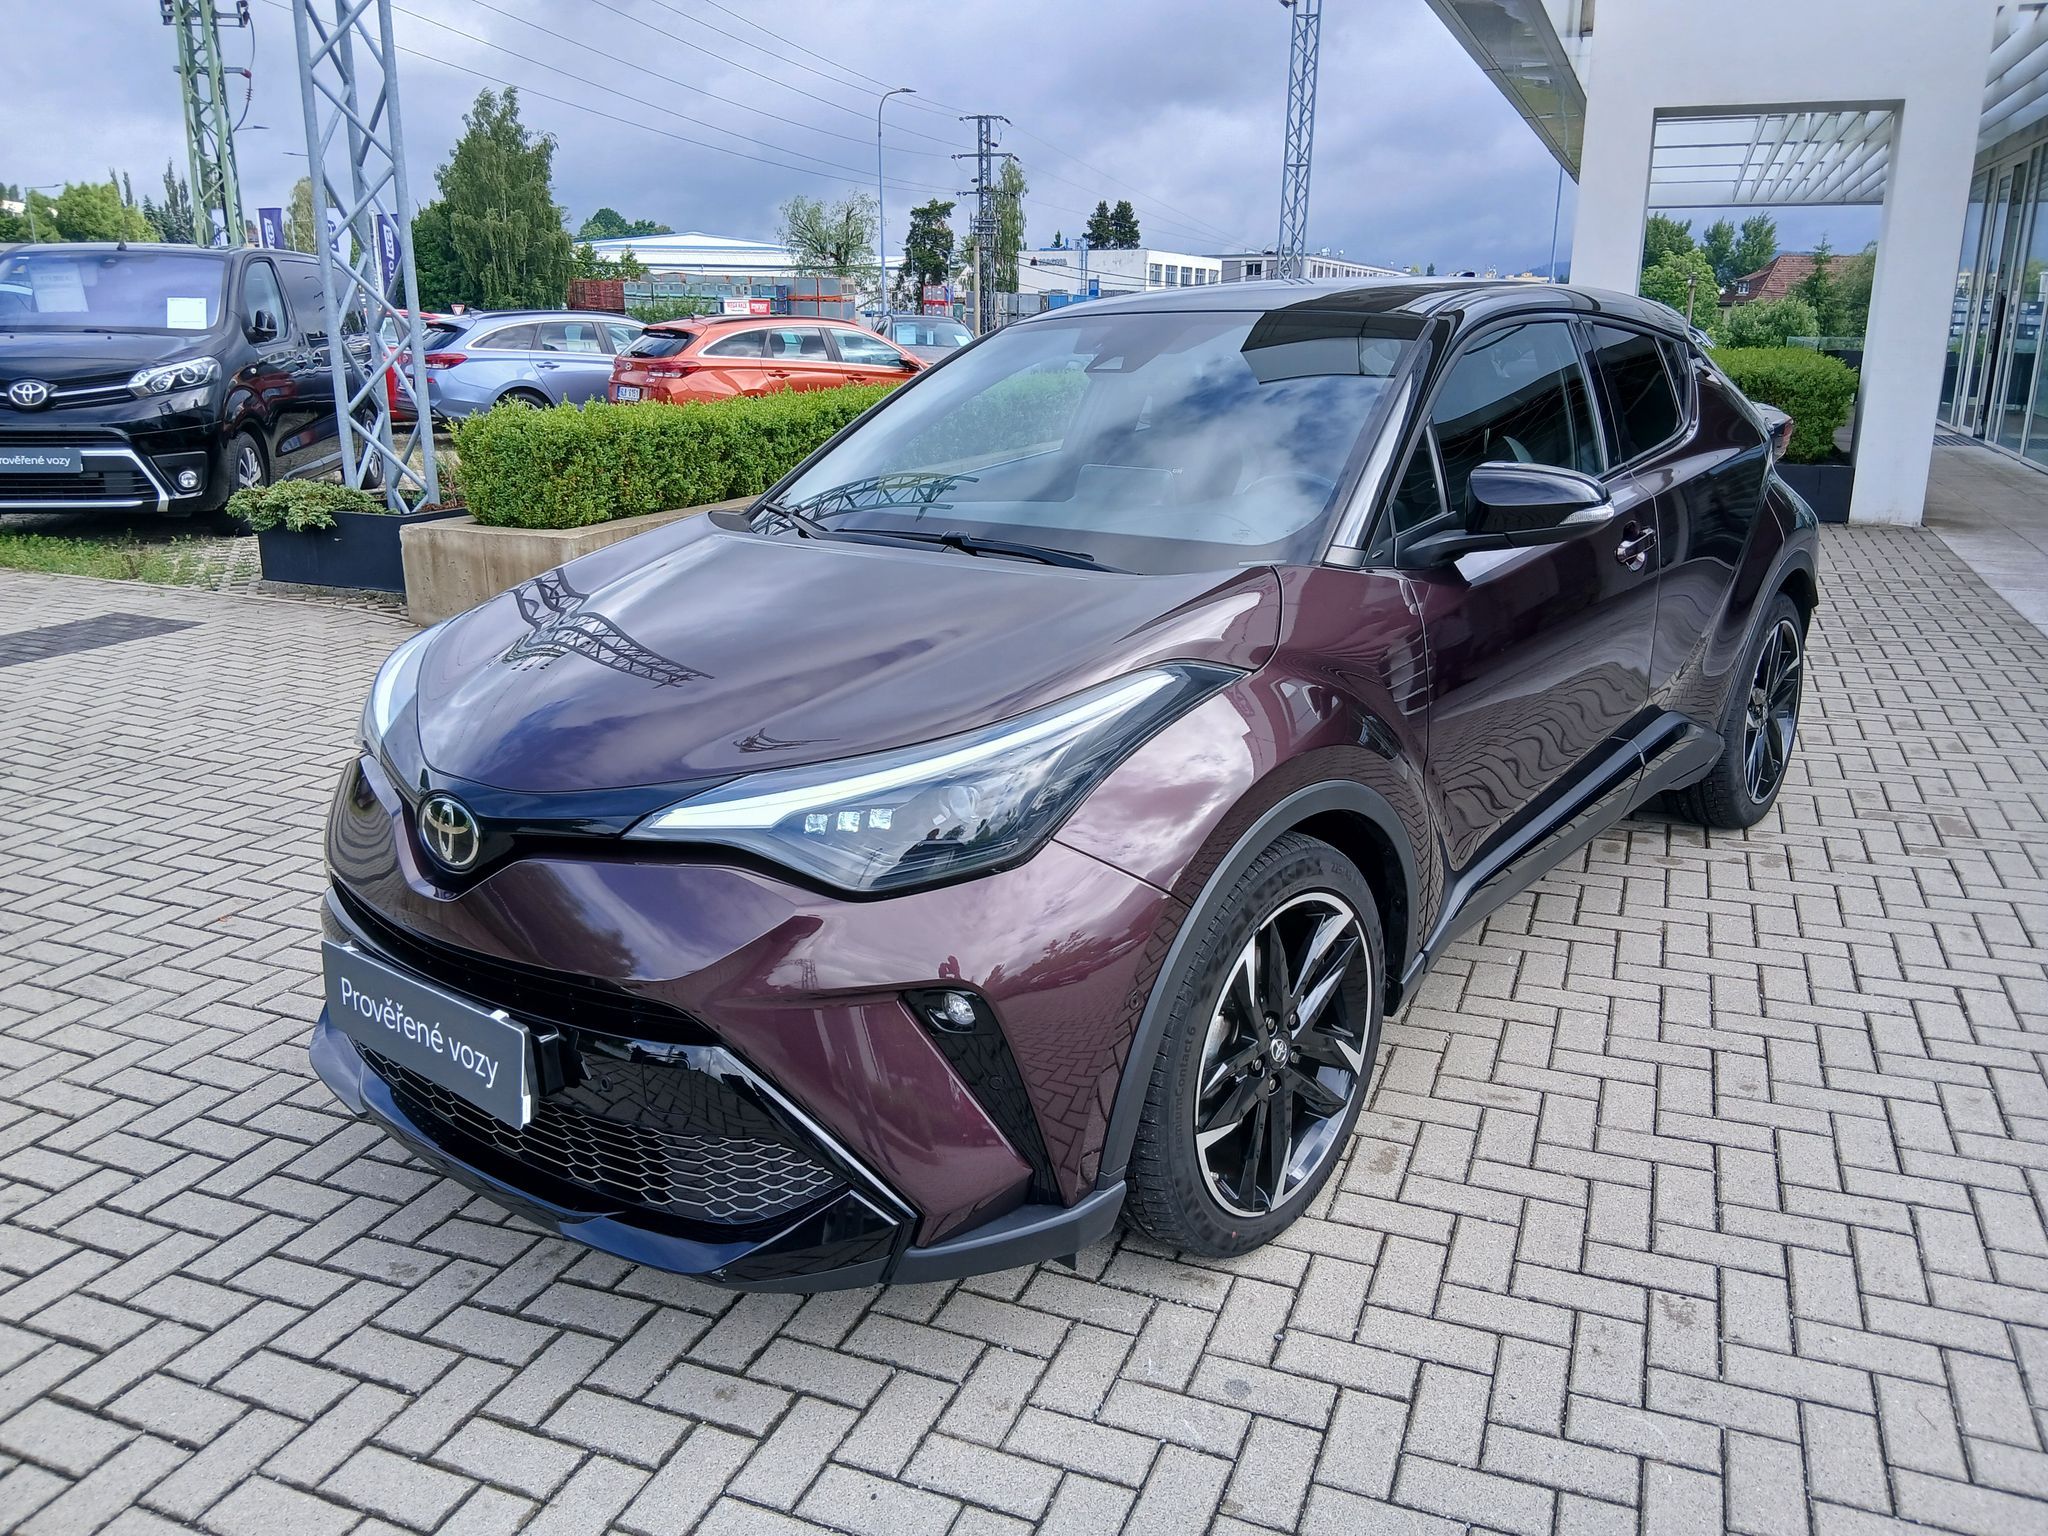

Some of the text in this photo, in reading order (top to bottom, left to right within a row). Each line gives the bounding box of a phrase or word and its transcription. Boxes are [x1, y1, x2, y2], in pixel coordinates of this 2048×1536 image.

[46, 457, 71, 467] vozy
[340, 976, 499, 1089] Prověřené vozy
